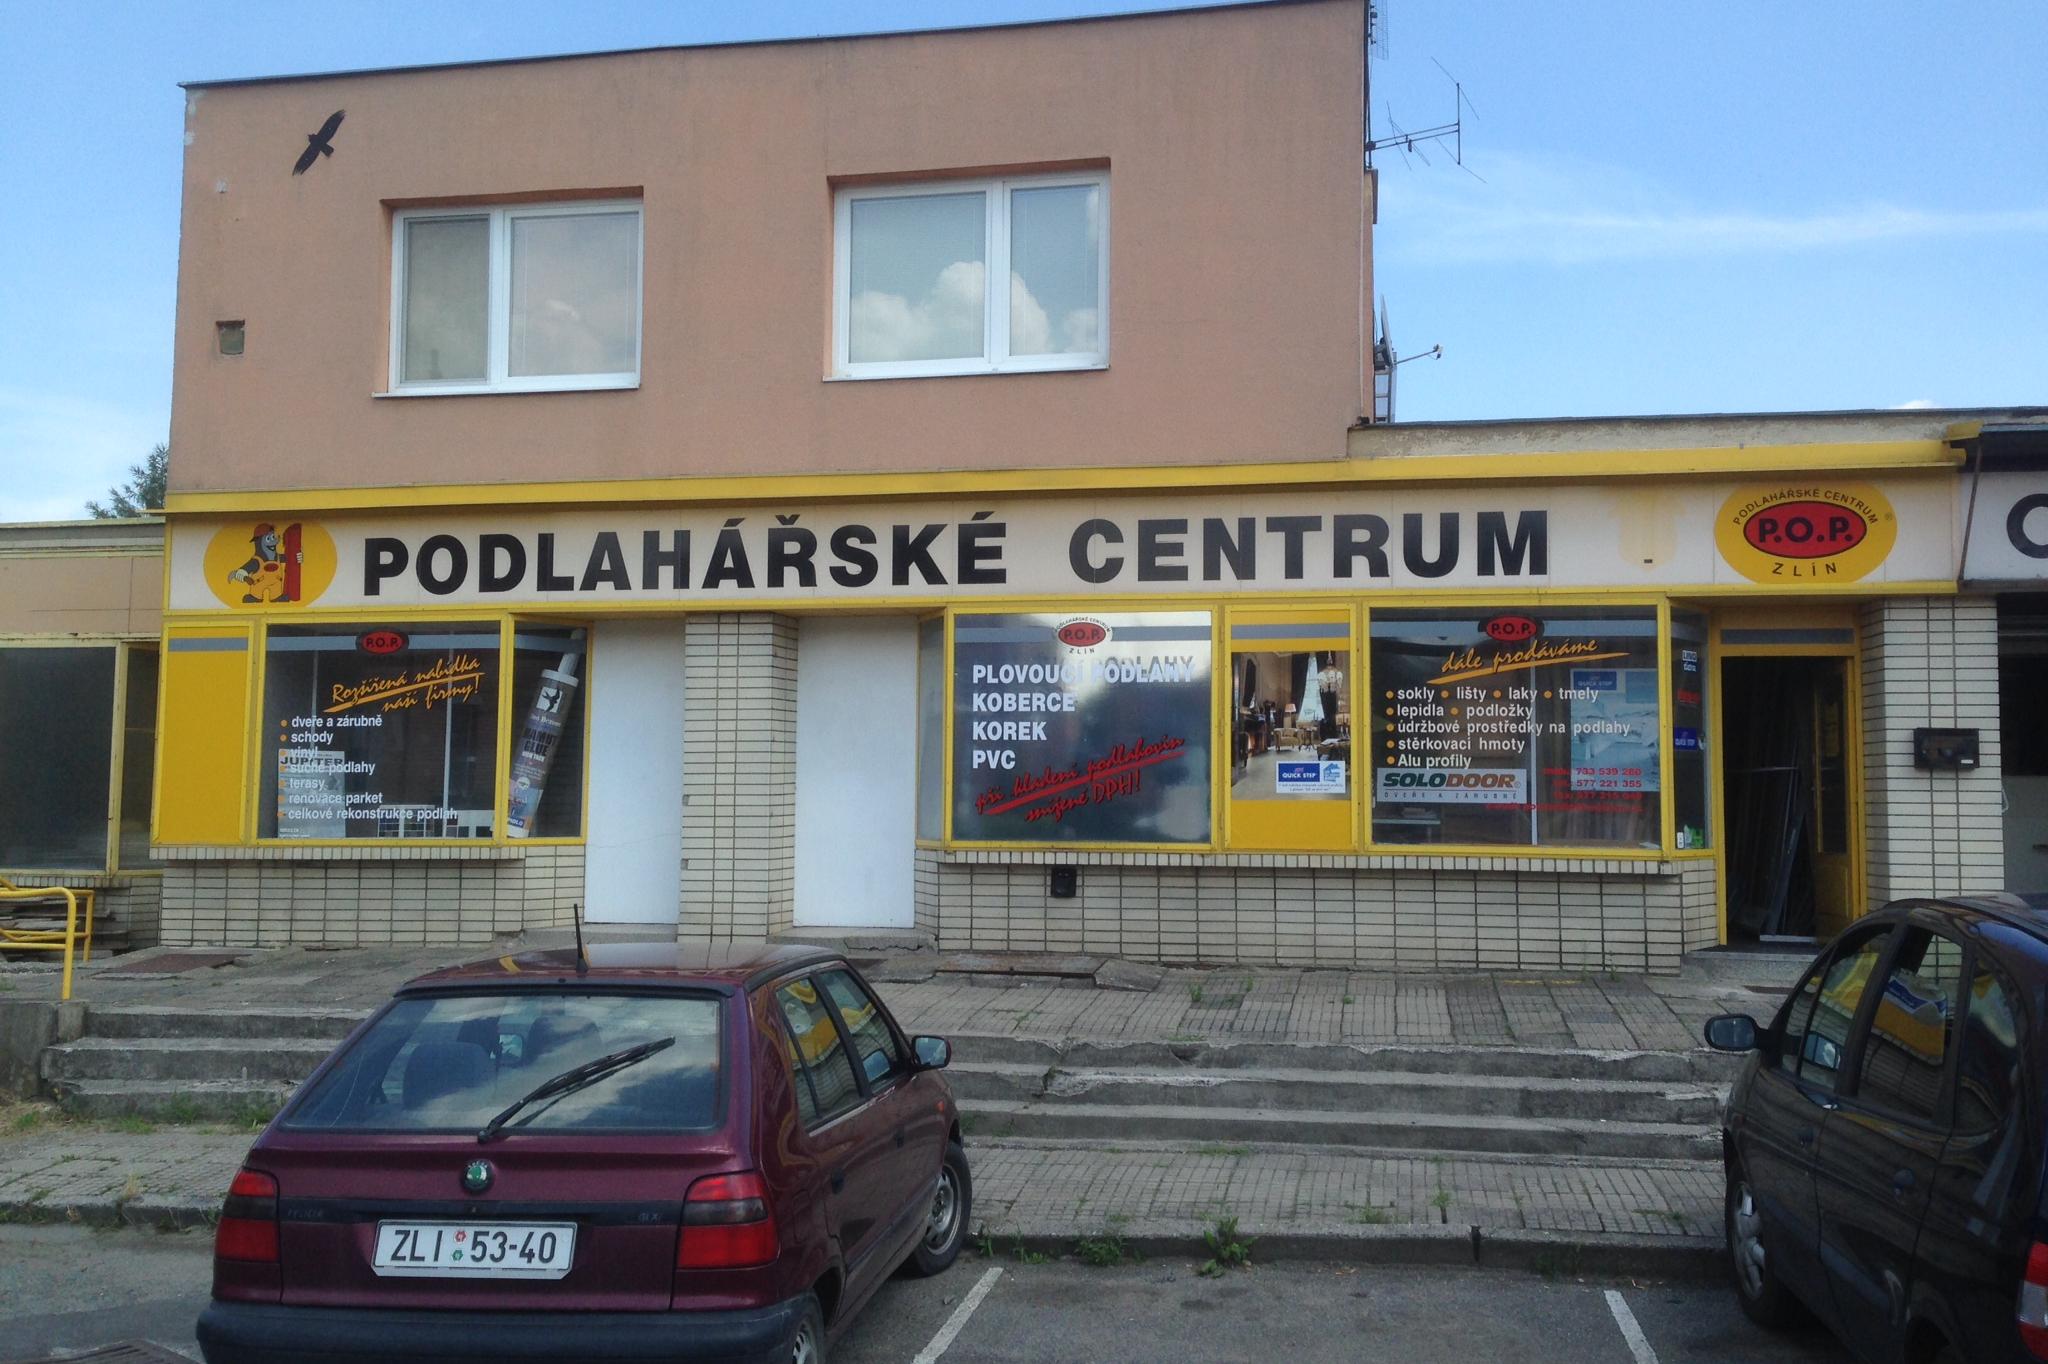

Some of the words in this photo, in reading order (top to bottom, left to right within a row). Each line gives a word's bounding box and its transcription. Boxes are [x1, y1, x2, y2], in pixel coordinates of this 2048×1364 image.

[1824, 490, 1878, 524] CENTRUM
[1758, 516, 1853, 543] P.O.P.
[363, 511, 1007, 596] PODLAHÁŘSKÉ
[1069, 510, 1548, 583] CENTRUM
[1772, 562, 1837, 577] ZLÍN
[1441, 649, 1483, 673] dále
[1493, 638, 1598, 673] prodáváme
[332, 670, 407, 705] Rozšířená
[415, 654, 480, 681] nabídka
[1092, 663, 1195, 683] PODLAHY
[382, 691, 418, 712] naší
[972, 693, 1076, 712] KOBERCE
[1397, 687, 1435, 702] sokly
[1457, 687, 1487, 702] lišty
[1509, 687, 1538, 702] laky
[1558, 687, 1599, 703] tmely
[326, 718, 333, 727] a
[336, 714, 383, 727] zárubně
[1397, 704, 1444, 721] lepidla
[1466, 703, 1534, 720] podložky
[972, 721, 1047, 741] KOREK
[1398, 720, 1460, 733] údržbové
[1466, 720, 1543, 736] prostředky
[1549, 722, 1566, 733] na
[1573, 720, 1630, 736] podlahy
[290, 730, 333, 745] schody
[1398, 737, 1471, 750] stěrkovací
[1479, 737, 1525, 753] hmoty
[972, 750, 1016, 769] PVC
[1397, 753, 1421, 767] Alu
[1426, 753, 1472, 769] profily
[328, 762, 376, 776] podlahy
[289, 777, 325, 790] terasy
[1383, 772, 1516, 788] SOLODOOR
[289, 793, 343, 804] renovace
[345, 792, 383, 808] parket
[288, 808, 333, 820] celkové
[336, 808, 414, 820] rekonstrukce
[416, 808, 458, 823] podlah
[390, 1229, 442, 1263] ZLI
[470, 1230, 557, 1264] 53-40
